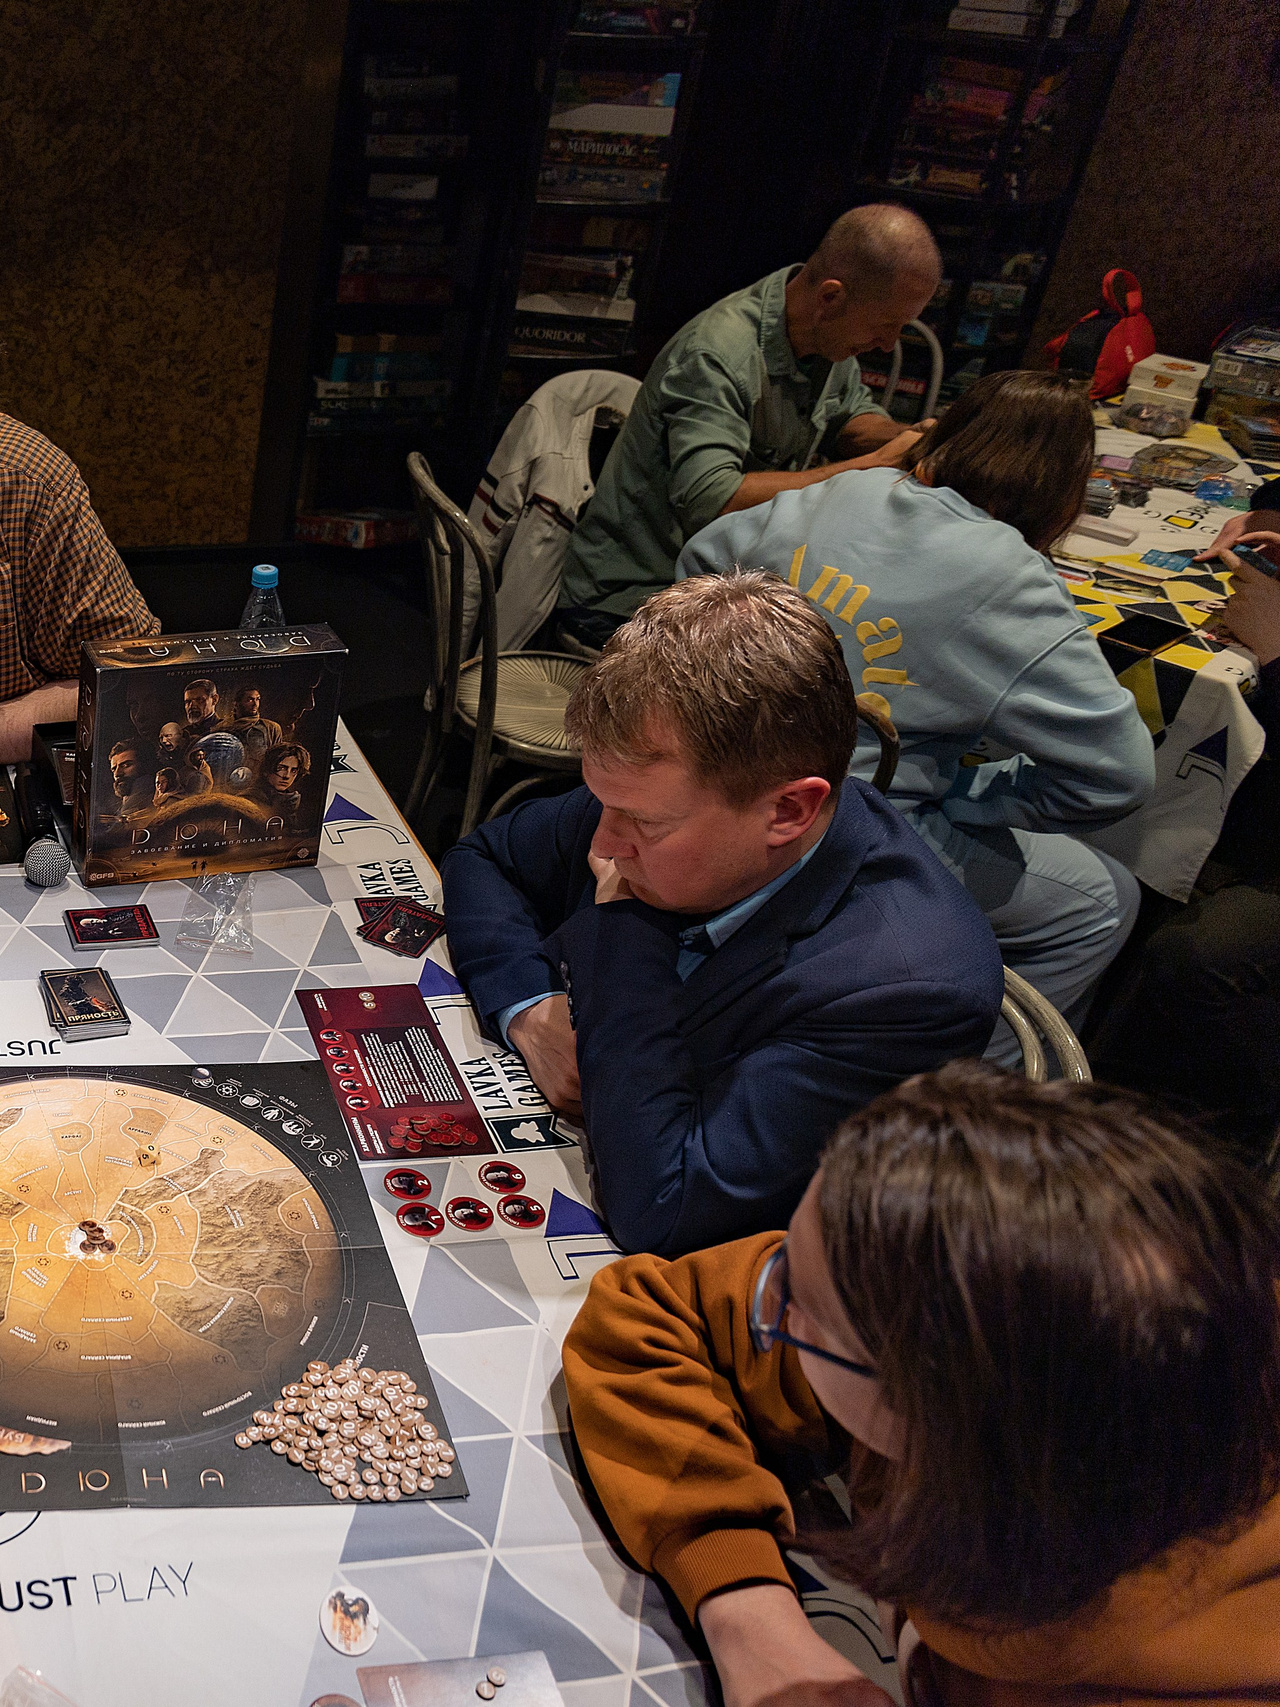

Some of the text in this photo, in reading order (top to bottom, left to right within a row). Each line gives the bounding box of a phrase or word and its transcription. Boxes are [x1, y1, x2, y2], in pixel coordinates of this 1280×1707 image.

[514, 325, 587, 344] QUORIDOR
[130, 843, 197, 855] ЗАВОЕВАНИЕ
[213, 836, 283, 847] ДИПЛОМАТИЯ
[357, 861, 395, 896] AVKA
[67, 1010, 120, 1022] ПРЯНОСТЬ
[459, 1056, 513, 1111] LAVKA
[350, 1117, 370, 1152] ХАРКОННЕНЫ
[478, 1206, 489, 1214] 4
[327, 1388, 336, 1396] 5
[344, 1385, 360, 1395] 10
[386, 1387, 397, 1397] 10
[289, 1400, 297, 1408] 2
[362, 1397, 375, 1407] 10
[326, 1403, 338, 1414] 10
[345, 1423, 354, 1434] 10
[422, 1425, 435, 1435] 10
[362, 1433, 375, 1443] 10
[336, 1465, 345, 1477] 10
[337, 1486, 344, 1495] 1
[354, 1486, 362, 1494] 2
[372, 1487, 380, 1495] 2
[389, 1488, 396, 1497] 2
[92, 1561, 193, 1604] PLAY
